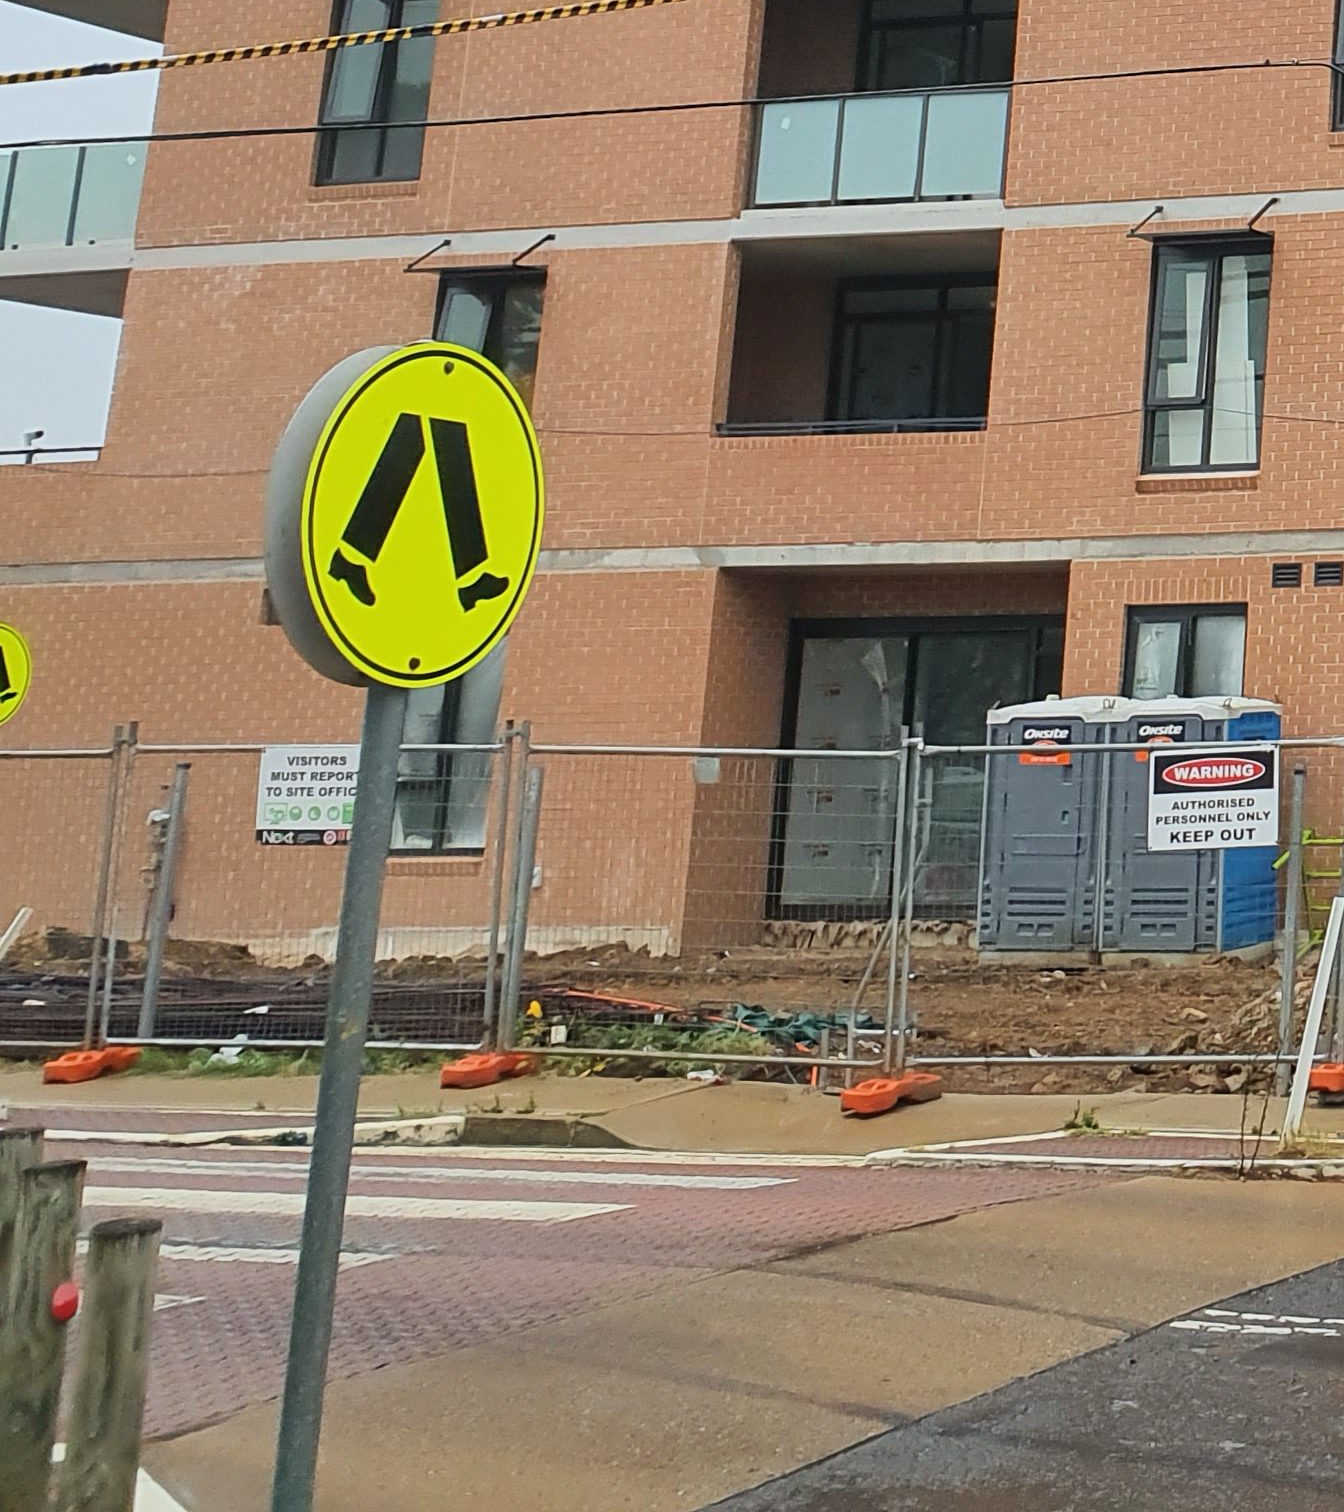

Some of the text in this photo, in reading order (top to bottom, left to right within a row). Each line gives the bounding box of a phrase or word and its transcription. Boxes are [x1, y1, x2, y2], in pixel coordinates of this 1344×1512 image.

[287, 756, 347, 766] VISITORS
[271, 771, 306, 781] MUST
[1173, 764, 1254, 780] WARNING
[266, 787, 357, 797] TO SITE OFFIC
[1172, 798, 1255, 810] AUTHORISED
[1156, 811, 1271, 825] PERSONNEL ONLY
[1170, 828, 1256, 843] KEEP OUT
